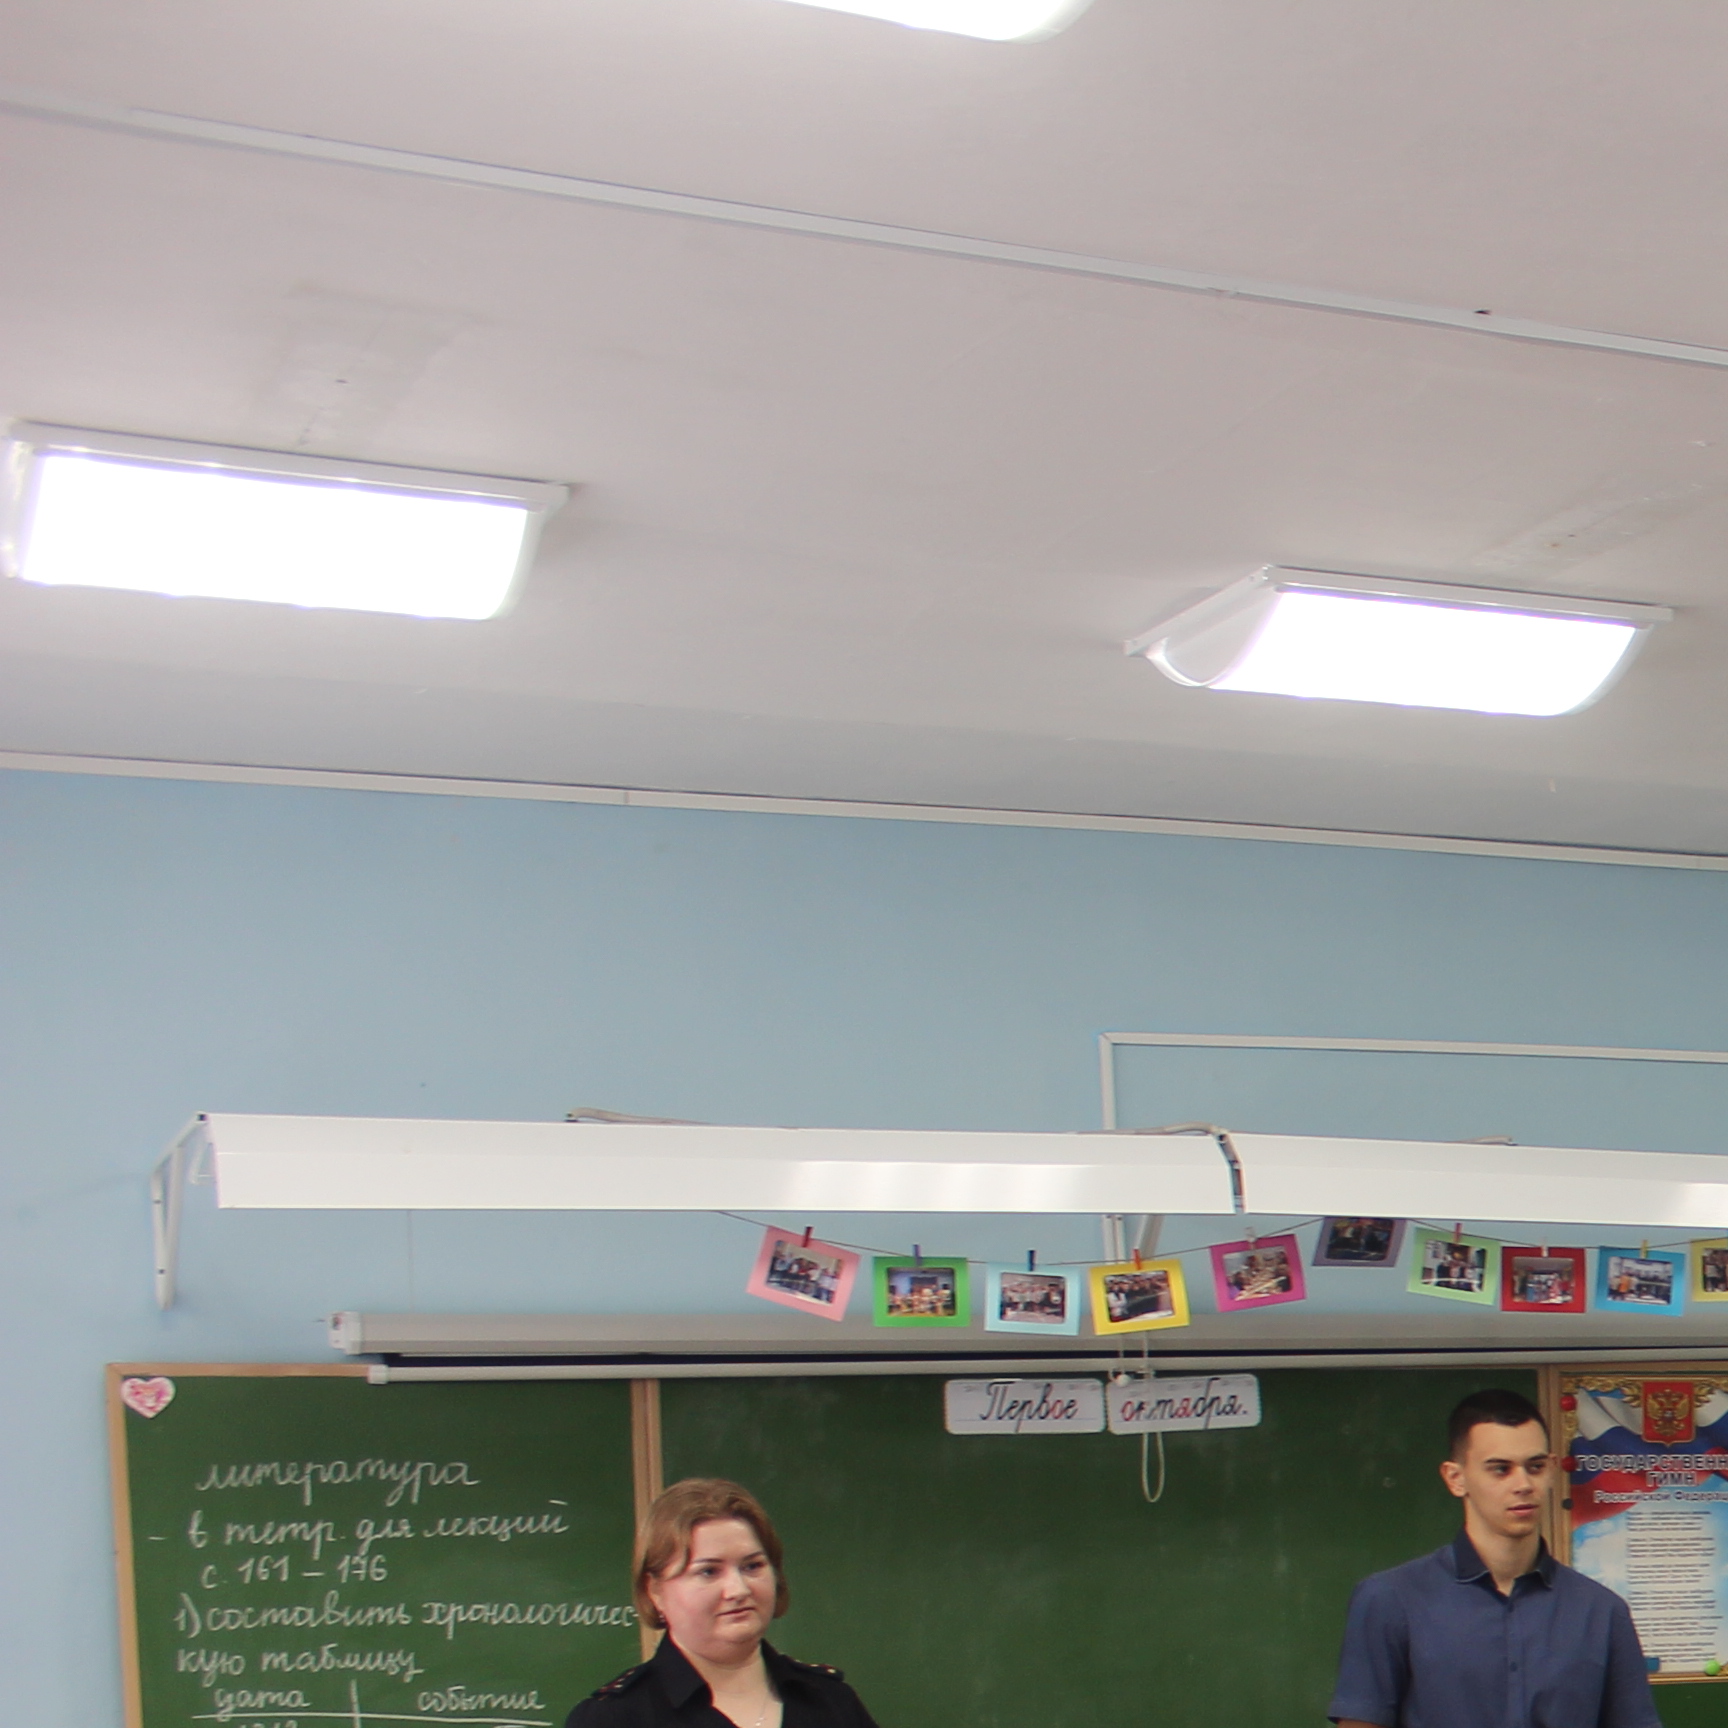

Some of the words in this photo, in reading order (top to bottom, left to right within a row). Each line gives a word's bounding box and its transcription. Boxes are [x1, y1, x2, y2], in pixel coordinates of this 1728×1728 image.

[980, 1380, 1079, 1433] Первое
[195, 1457, 481, 1506] литература
[1594, 1489, 1670, 1504] Российской
[1646, 1471, 1697, 1487] ГИМН
[356, 1515, 414, 1556] для
[238, 1555, 290, 1585] 161
[337, 1553, 388, 1583] 176
[178, 1646, 246, 1689] кую
